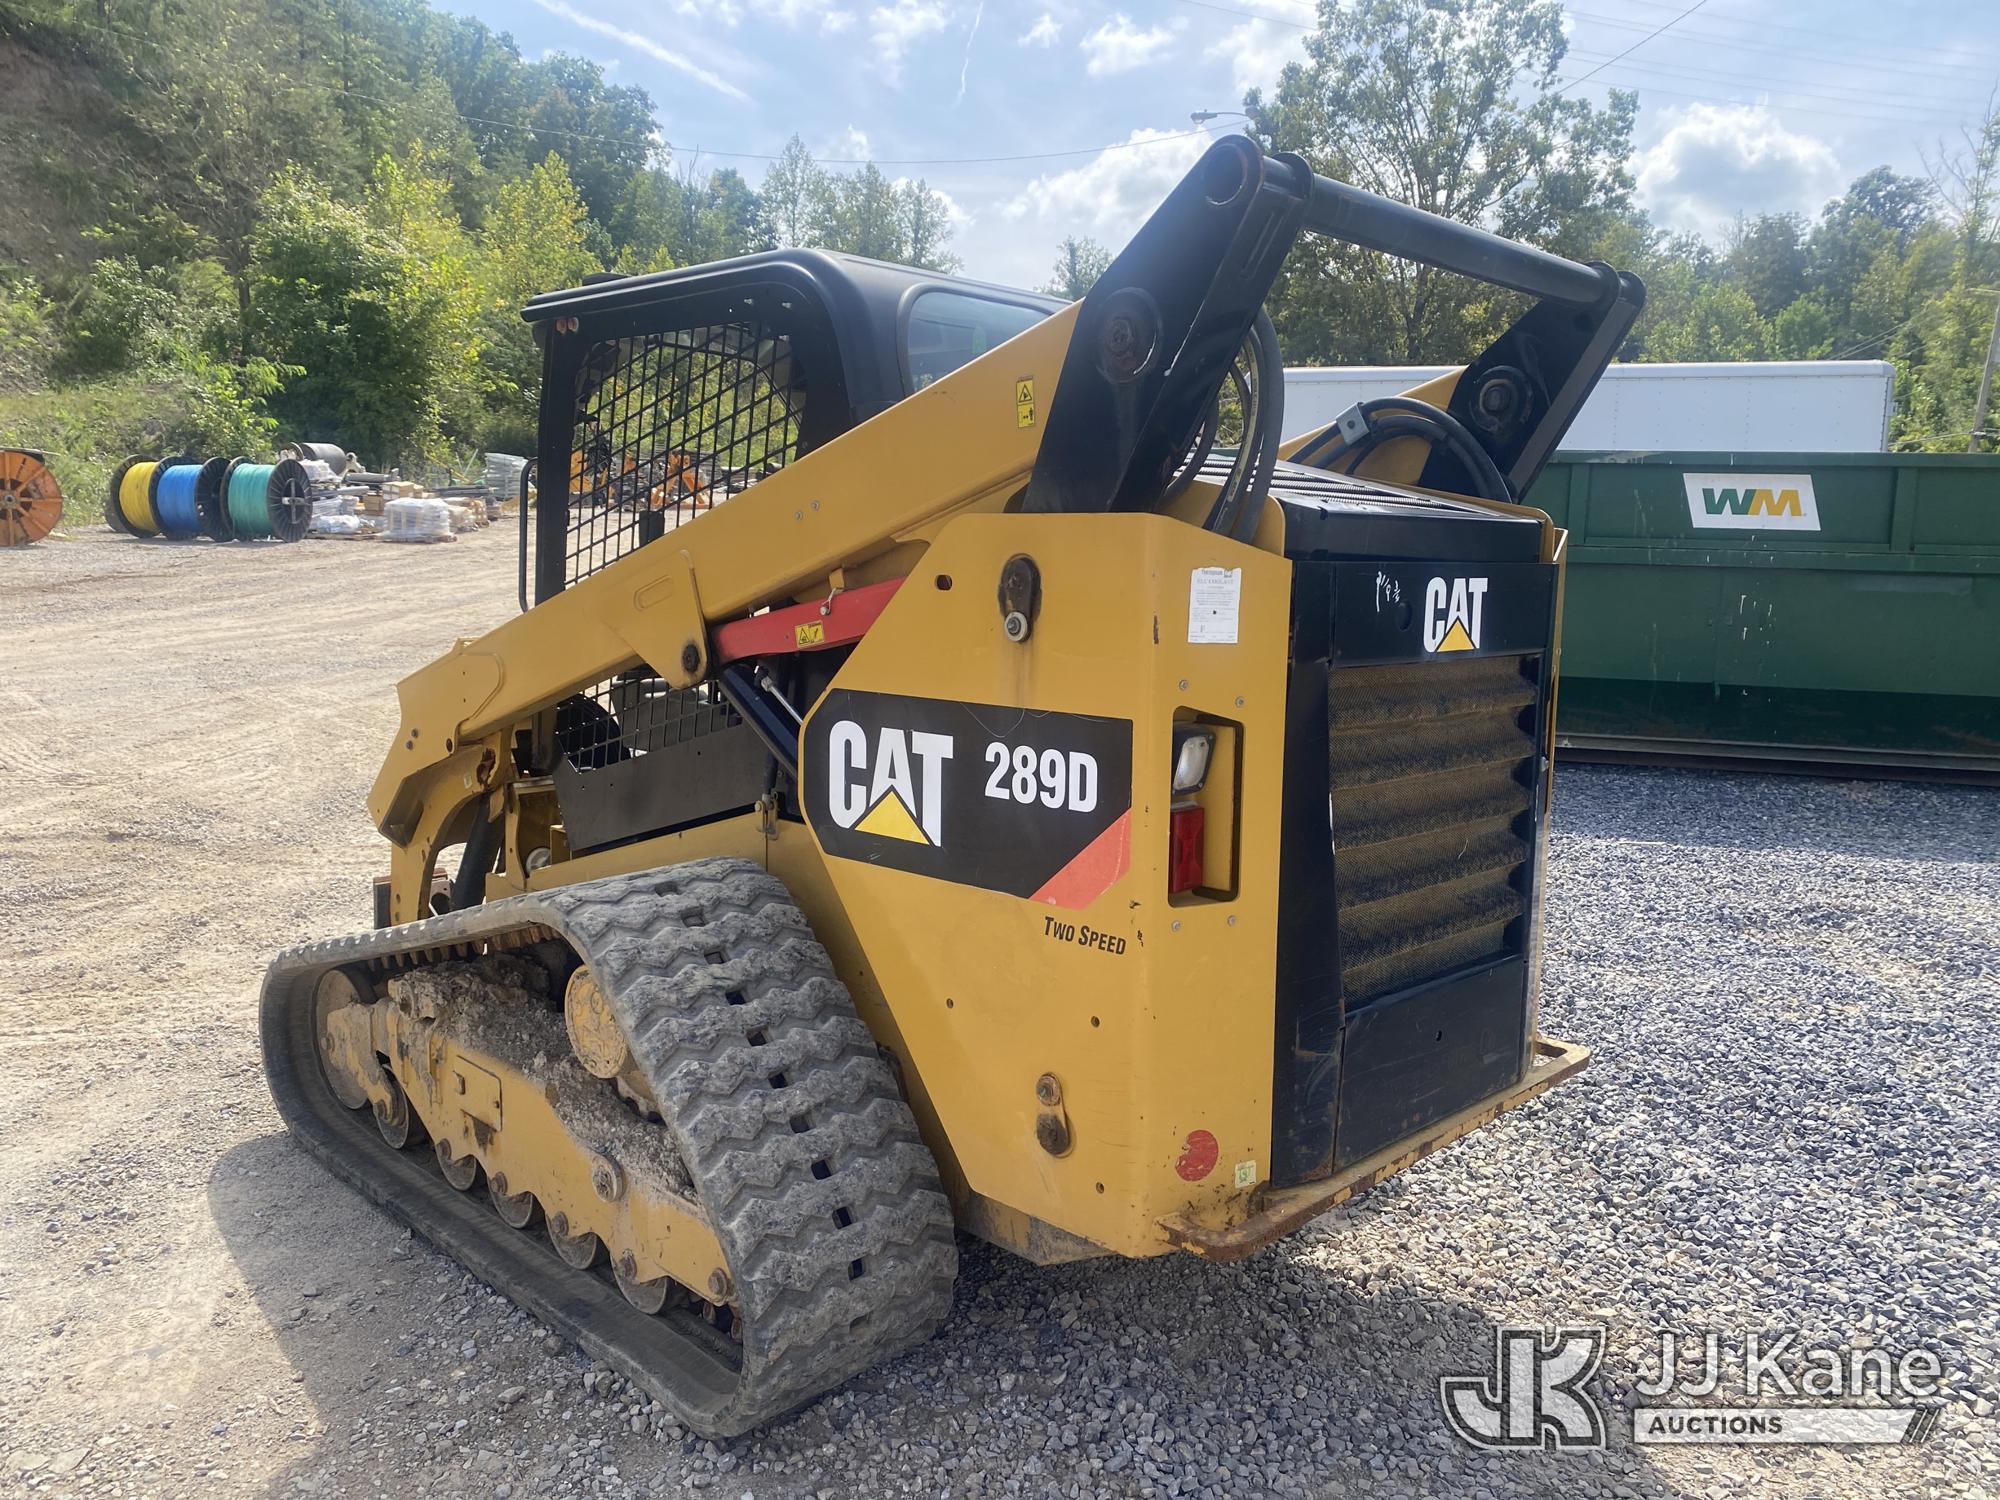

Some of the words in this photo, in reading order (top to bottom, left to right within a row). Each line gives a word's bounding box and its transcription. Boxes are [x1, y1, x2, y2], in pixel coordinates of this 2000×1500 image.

[1702, 488, 1802, 516] WM
[1423, 577, 1489, 653] CAT
[829, 720, 954, 848] CAT
[984, 741, 1098, 813] 289D
